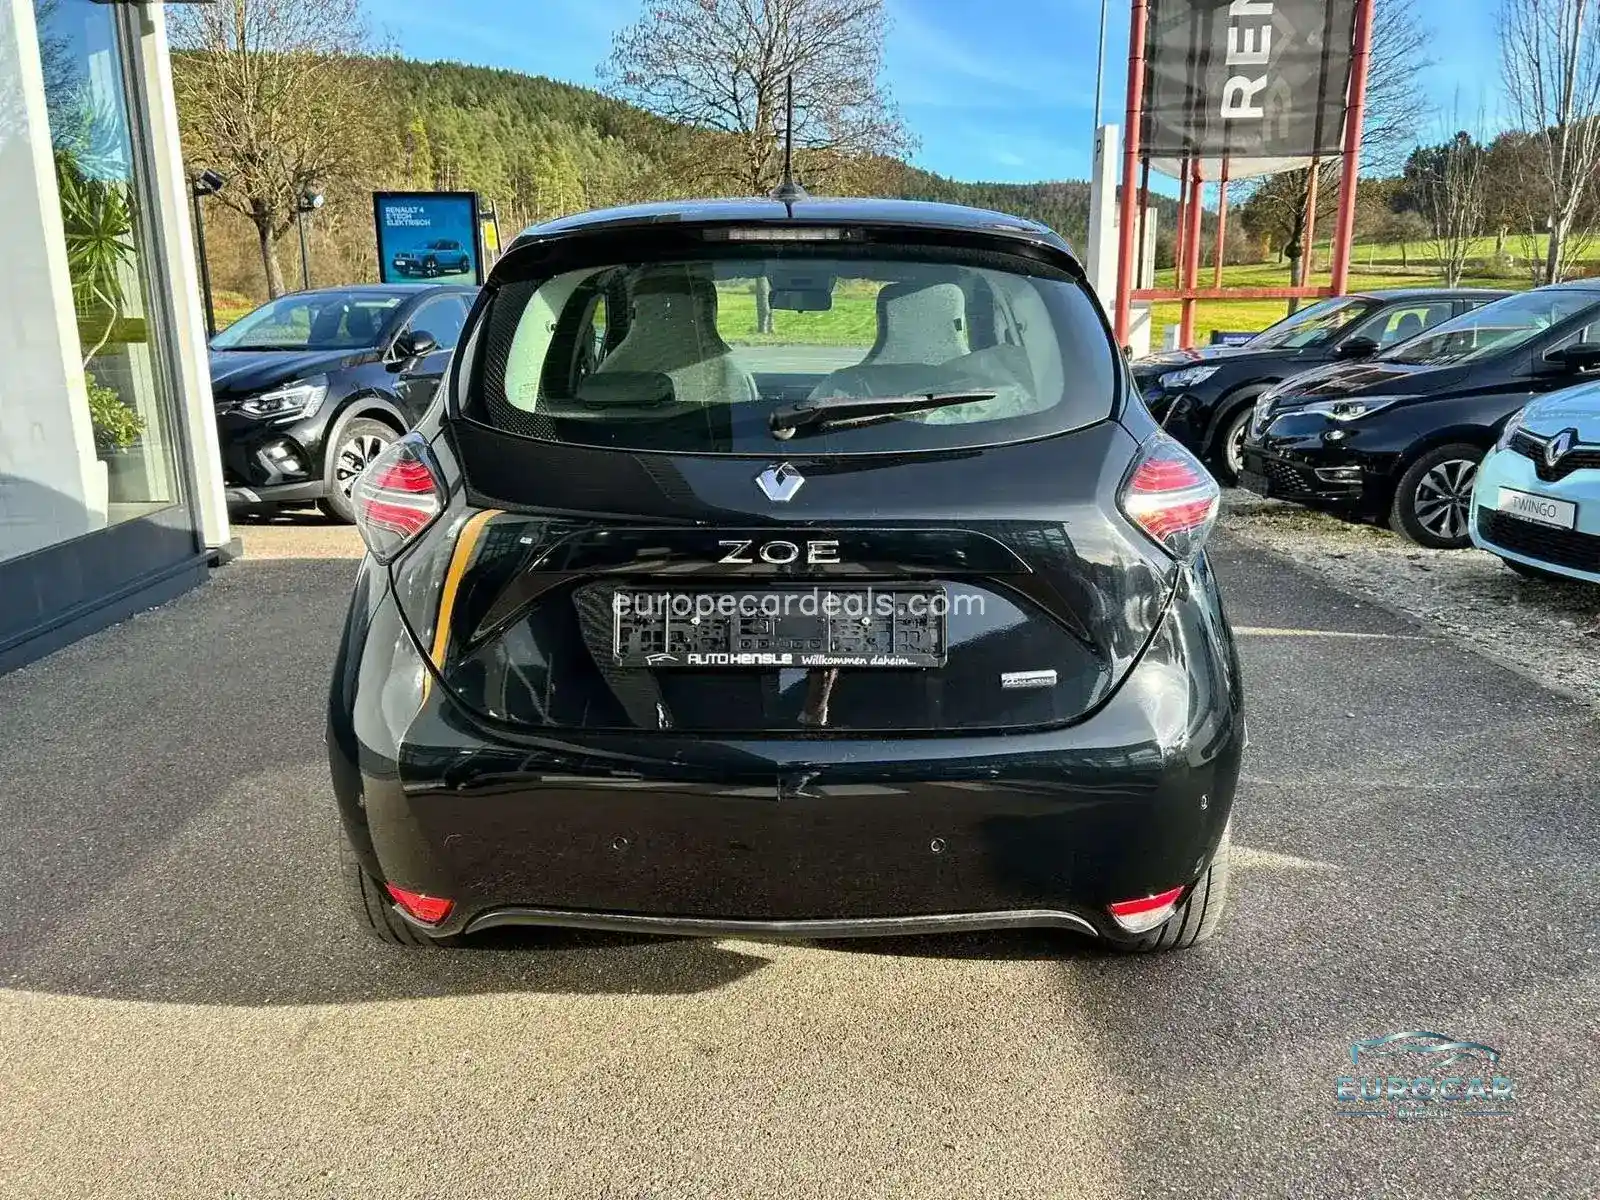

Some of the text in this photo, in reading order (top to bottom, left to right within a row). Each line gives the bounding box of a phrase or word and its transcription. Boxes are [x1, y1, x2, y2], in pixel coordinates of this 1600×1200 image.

[385, 206, 424, 214] RENAULT 4
[1512, 496, 1557, 518] TWINGO
[718, 539, 841, 564] ZOE
[801, 654, 867, 666] Willkommen
